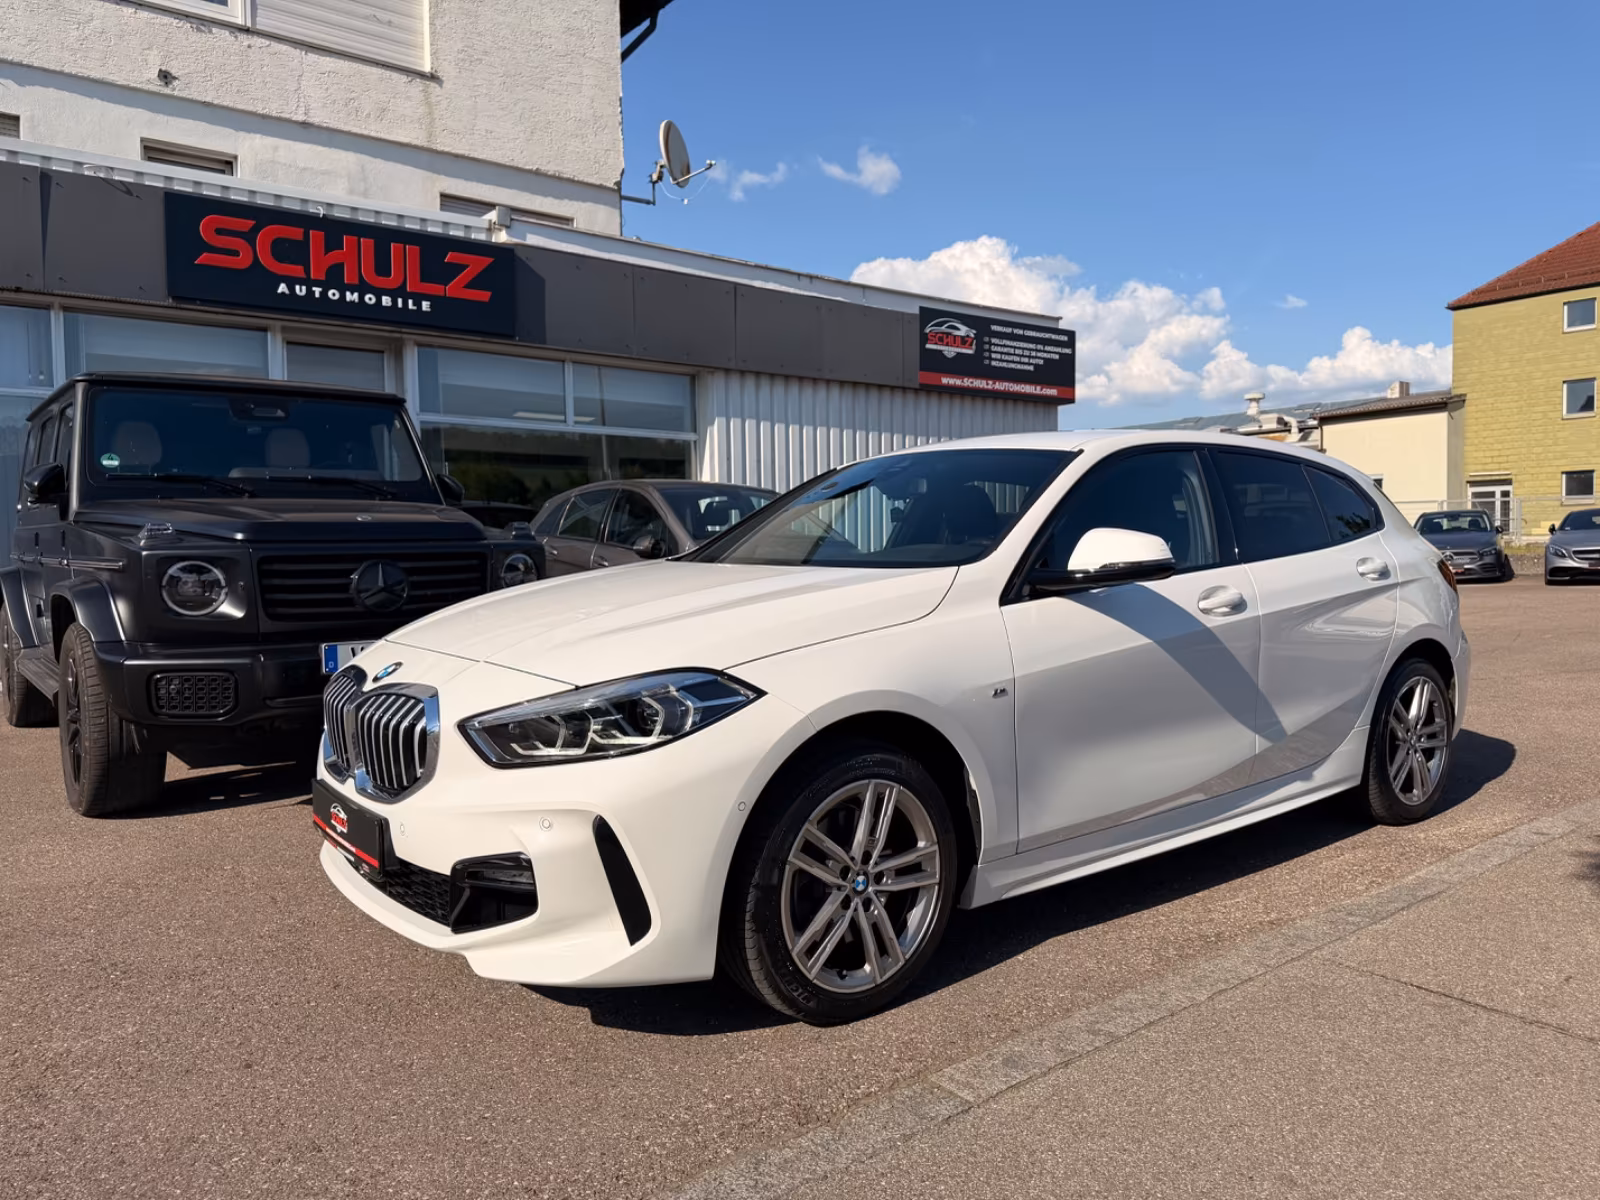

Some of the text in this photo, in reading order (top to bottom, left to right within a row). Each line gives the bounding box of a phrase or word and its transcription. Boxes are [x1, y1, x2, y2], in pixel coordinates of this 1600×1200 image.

[194, 214, 495, 303] SCHULZ
[277, 282, 432, 312] AUTOMOBILE
[928, 332, 973, 349] SCHULZ
[941, 376, 1057, 395] www.SCHULZ-AUTOMOBILE.com
[328, 661, 335, 669] D
